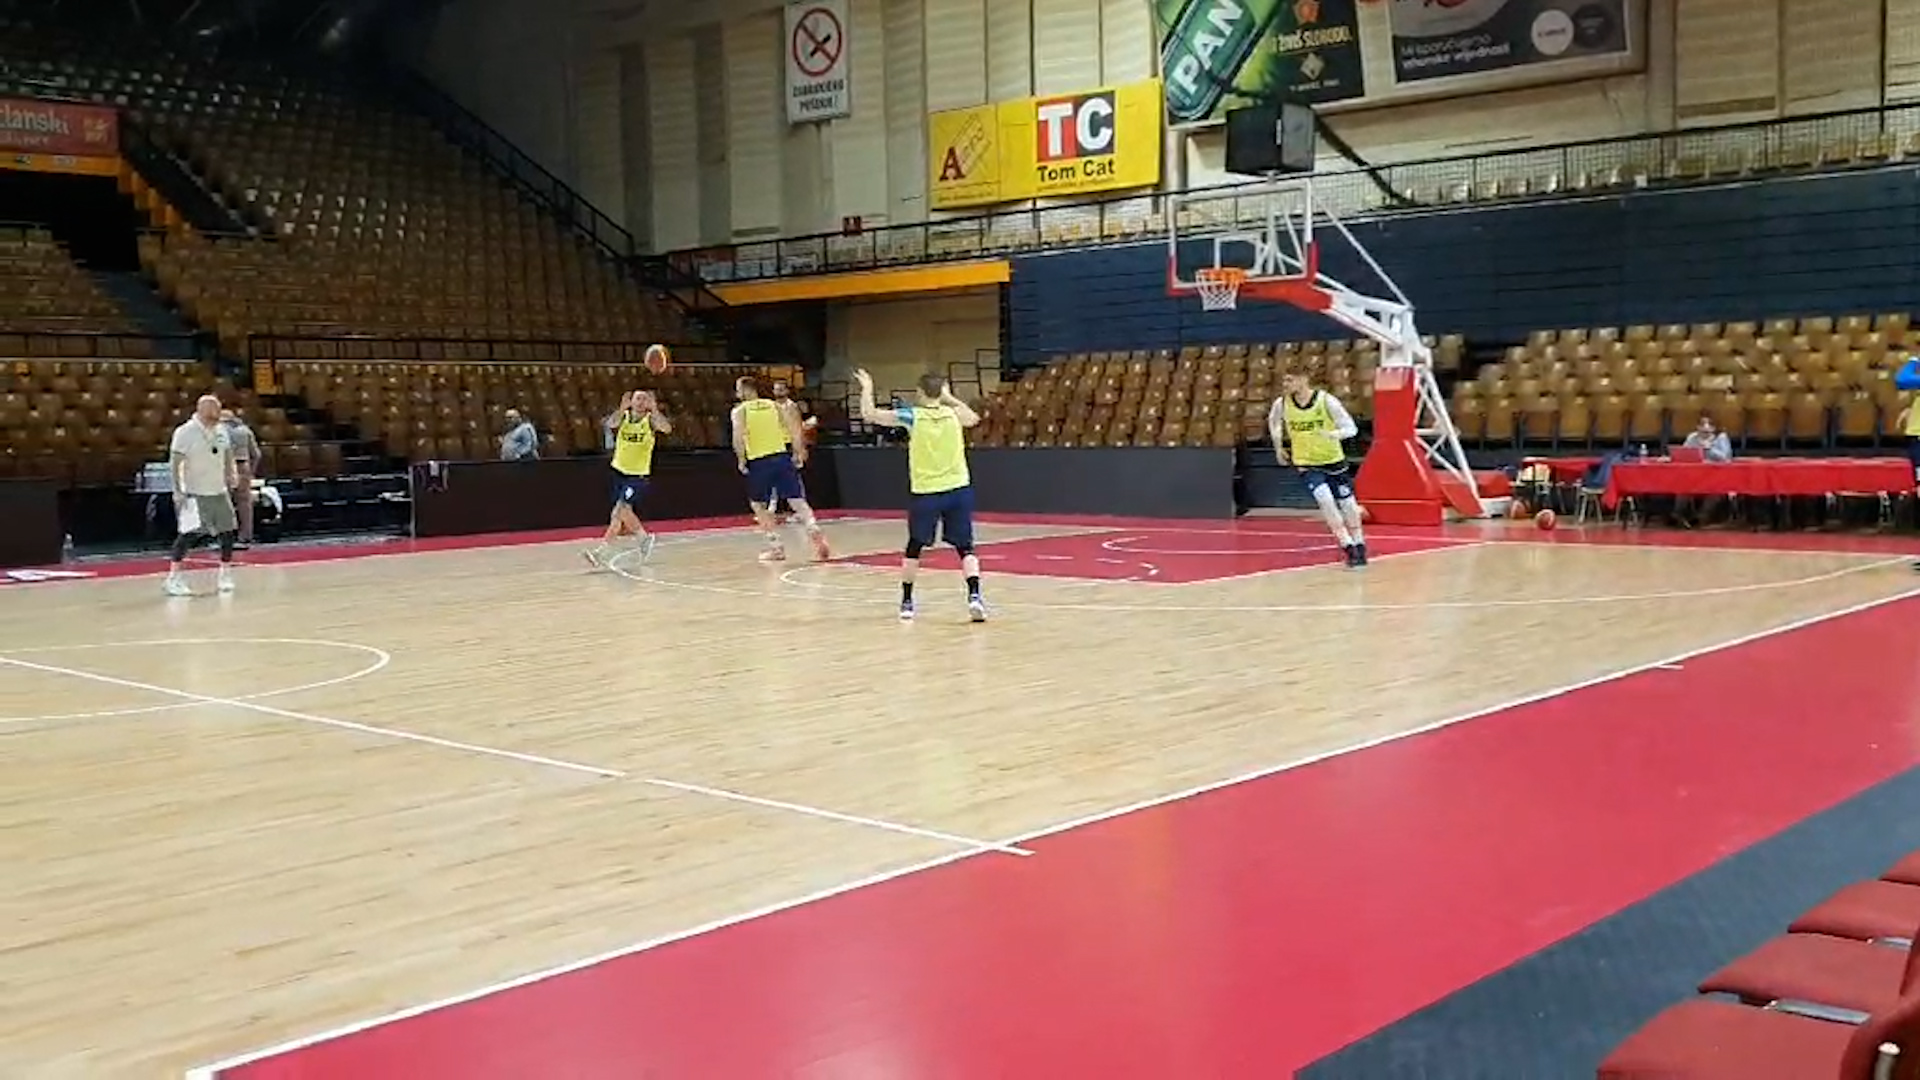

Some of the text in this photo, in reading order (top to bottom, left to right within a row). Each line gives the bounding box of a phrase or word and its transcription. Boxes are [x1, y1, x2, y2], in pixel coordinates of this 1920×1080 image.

[1172, 0, 1243, 95] PAN
[1038, 97, 1113, 157] TC
[1037, 159, 1115, 182] Tom Cat
